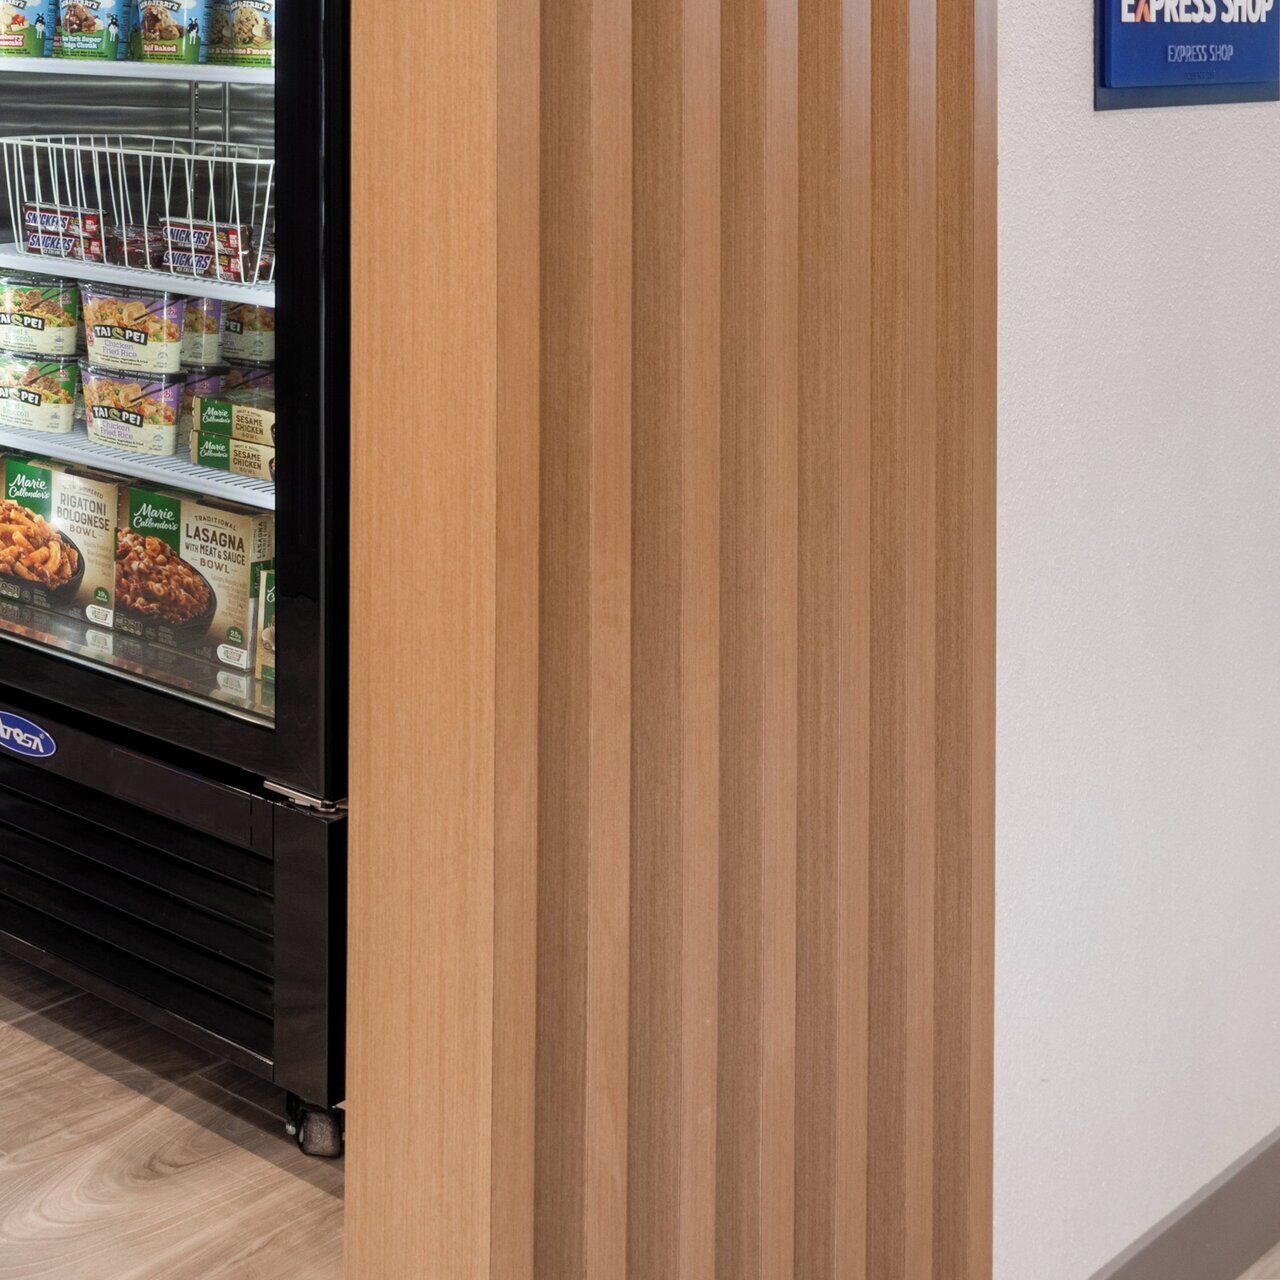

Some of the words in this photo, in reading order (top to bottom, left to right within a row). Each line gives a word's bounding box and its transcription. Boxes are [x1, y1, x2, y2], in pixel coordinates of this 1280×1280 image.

[1168, 44, 1208, 63] EXPRESS
[1209, 45, 1234, 62] SHOP
[163, 226, 210, 245] SNICKERS
[29, 236, 73, 251] SNICKERS
[163, 252, 211, 269] SNICKERS
[23, 318, 43, 329] PEI
[94, 326, 111, 337] TAI
[125, 331, 145, 344] PEI
[102, 346, 119, 356] Fried
[120, 349, 137, 359] Rice
[104, 339, 134, 351] Chicken
[21, 393, 39, 404] PEI
[93, 406, 109, 417] TAI
[122, 412, 141, 426] PEI
[203, 406, 229, 417] Marie
[102, 421, 131, 432] Chicken
[236, 415, 263, 427] SESAME
[100, 428, 116, 437] Fried
[117, 431, 134, 440] Rice
[235, 423, 264, 436] CHICKEN
[200, 441, 227, 452] Marie
[233, 449, 261, 462] SESAME
[233, 457, 261, 470] CHICKEN
[9, 473, 48, 490] Marie
[8, 485, 50, 499] Callender's
[60, 493, 107, 516] RIGATONI
[133, 503, 176, 521] Marie
[56, 506, 110, 532] BOLOGNESE
[133, 516, 178, 531] Callender's
[194, 515, 237, 532] TRADITIONAL
[69, 524, 97, 539] BOWL
[185, 523, 245, 553] LASAGNA
[185, 543, 199, 553] WITH
[199, 543, 217, 558] MEAT
[217, 551, 223, 560] &
[223, 551, 246, 566] SAUCE
[199, 557, 230, 574] BOWL
